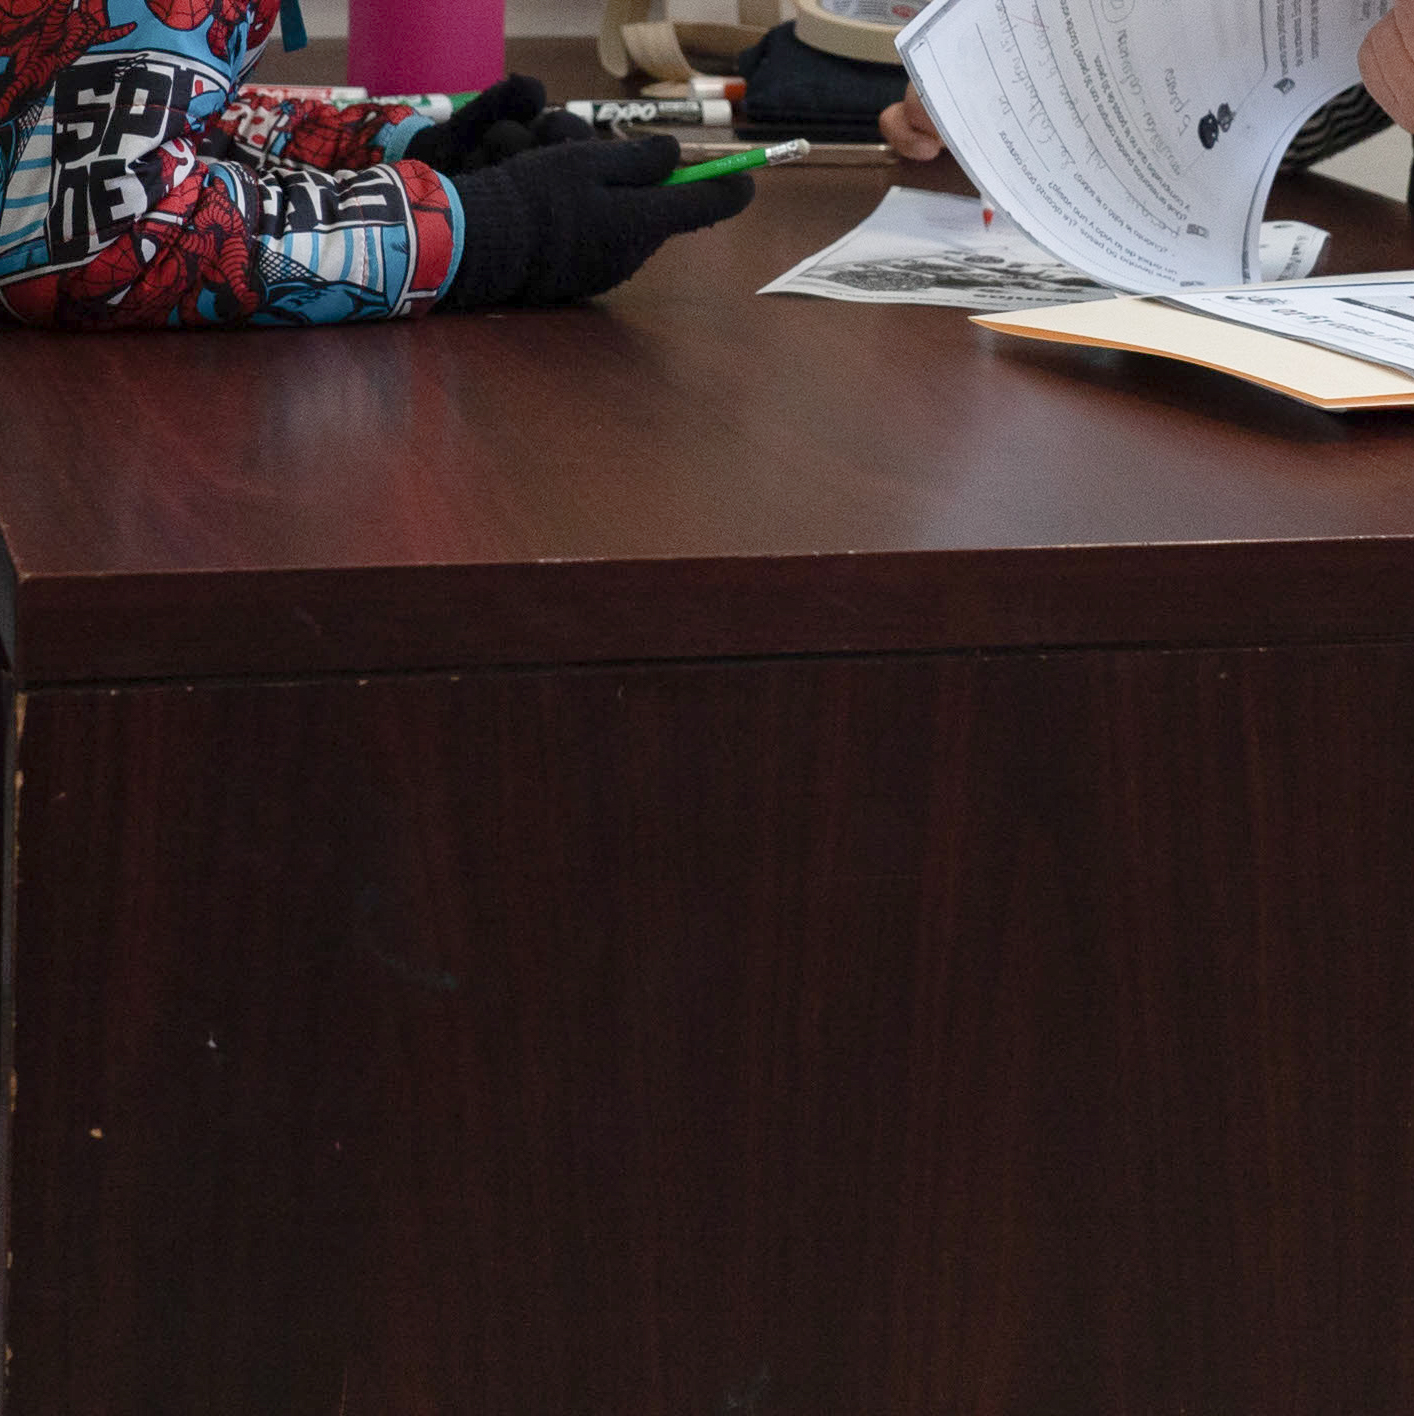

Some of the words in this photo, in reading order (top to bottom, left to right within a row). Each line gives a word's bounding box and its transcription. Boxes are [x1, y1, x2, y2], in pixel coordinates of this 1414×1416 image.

[1064, 17, 1079, 47] Escribe
[1072, 47, 1090, 75] pesos?
[1094, 102, 1116, 139] comprar
[997, 130, 1024, 166] comprar
[1112, 136, 1135, 166] puedes
[1019, 163, 1037, 184] para
[1072, 206, 1088, 222] una
[1094, 226, 1114, 243] vida
